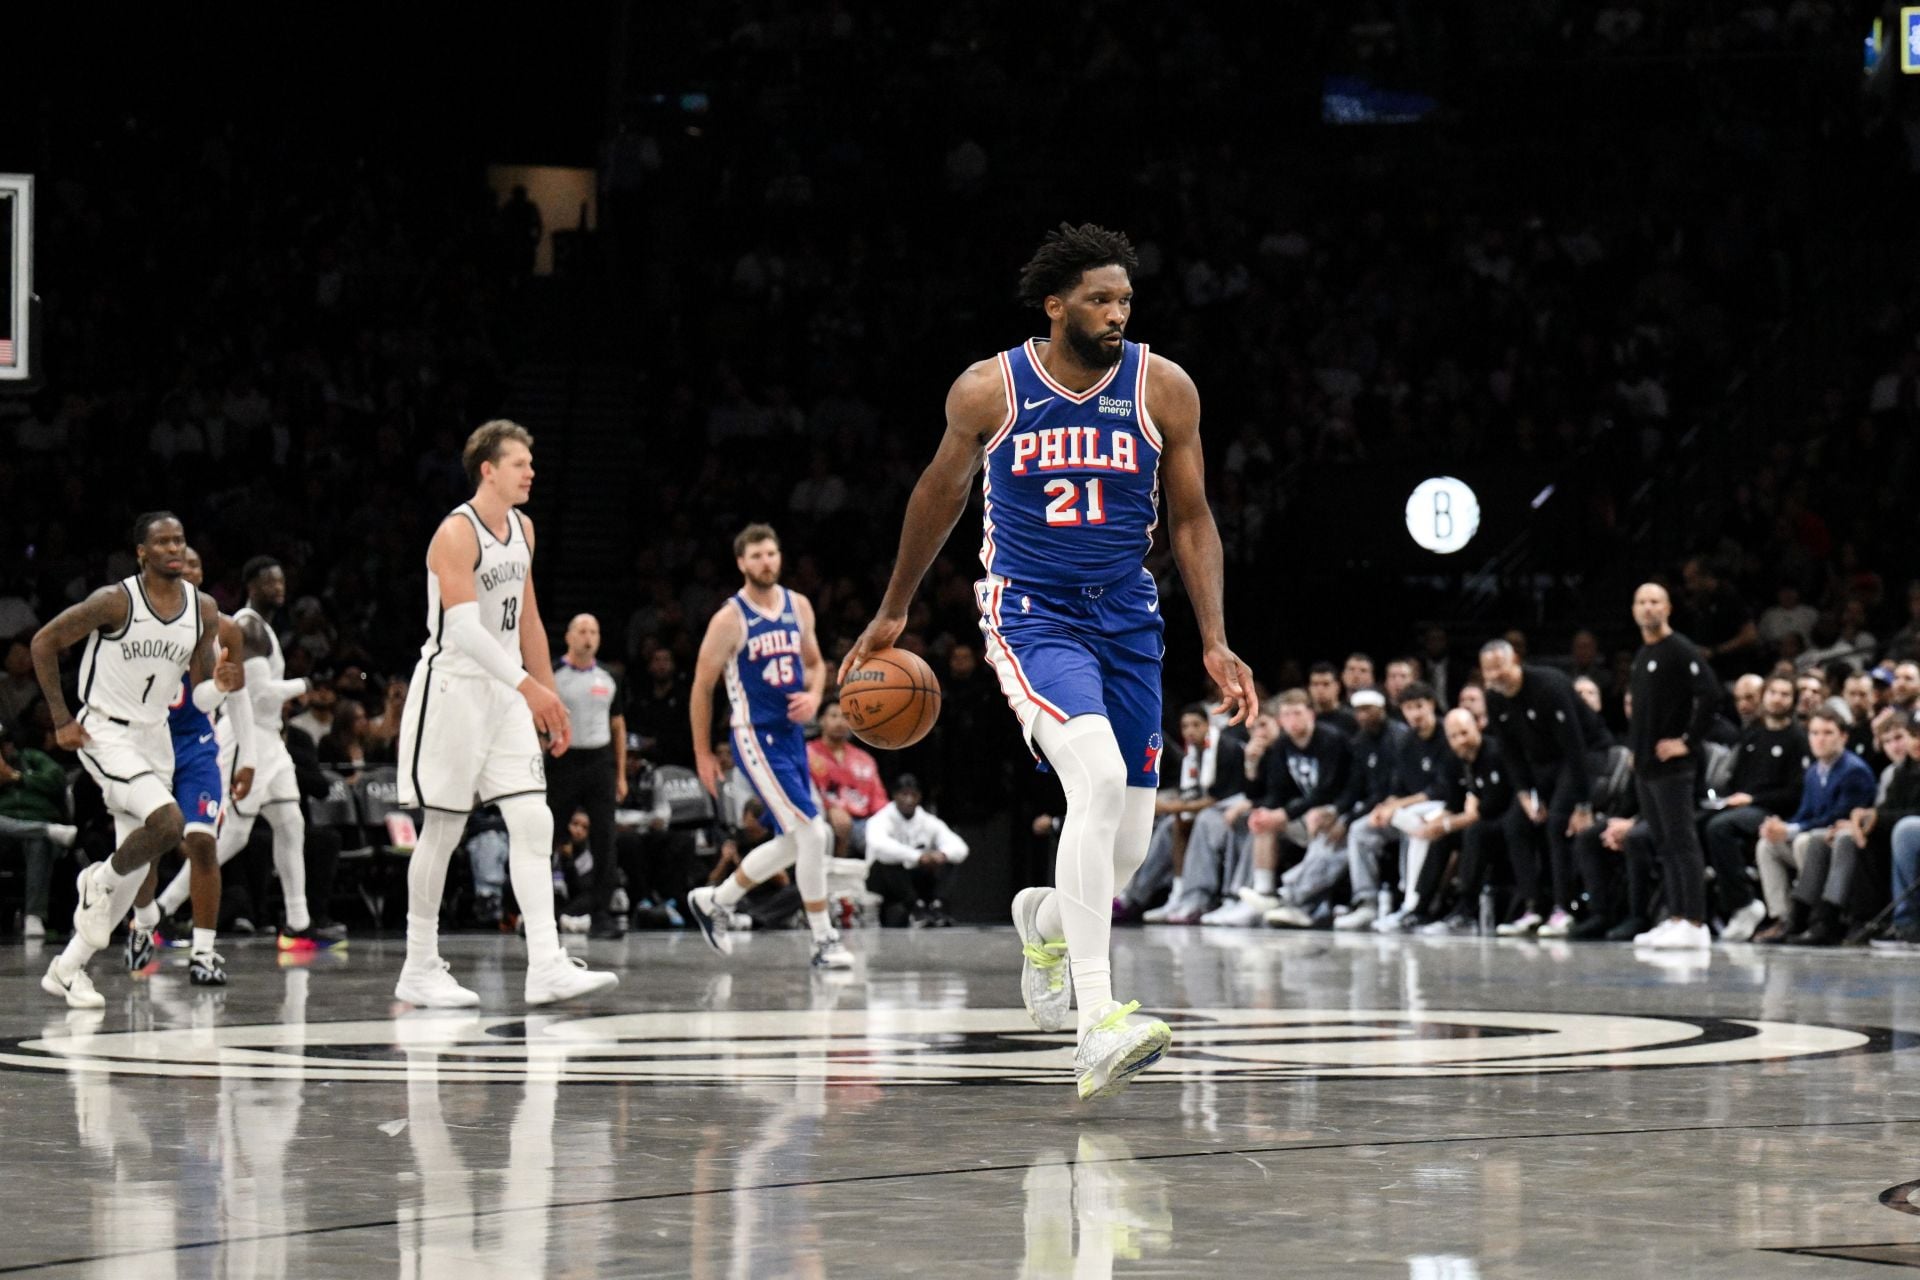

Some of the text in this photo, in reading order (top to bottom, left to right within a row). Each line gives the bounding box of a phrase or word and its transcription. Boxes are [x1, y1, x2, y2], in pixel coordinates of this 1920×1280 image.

[1098, 405, 1132, 417] energy
[1099, 396, 1132, 407] Bloom
[1011, 426, 1140, 477] PHILA
[1043, 478, 1107, 528] 21
[501, 596, 517, 632] 13
[762, 655, 797, 687] 45
[142, 673, 156, 705] 1
